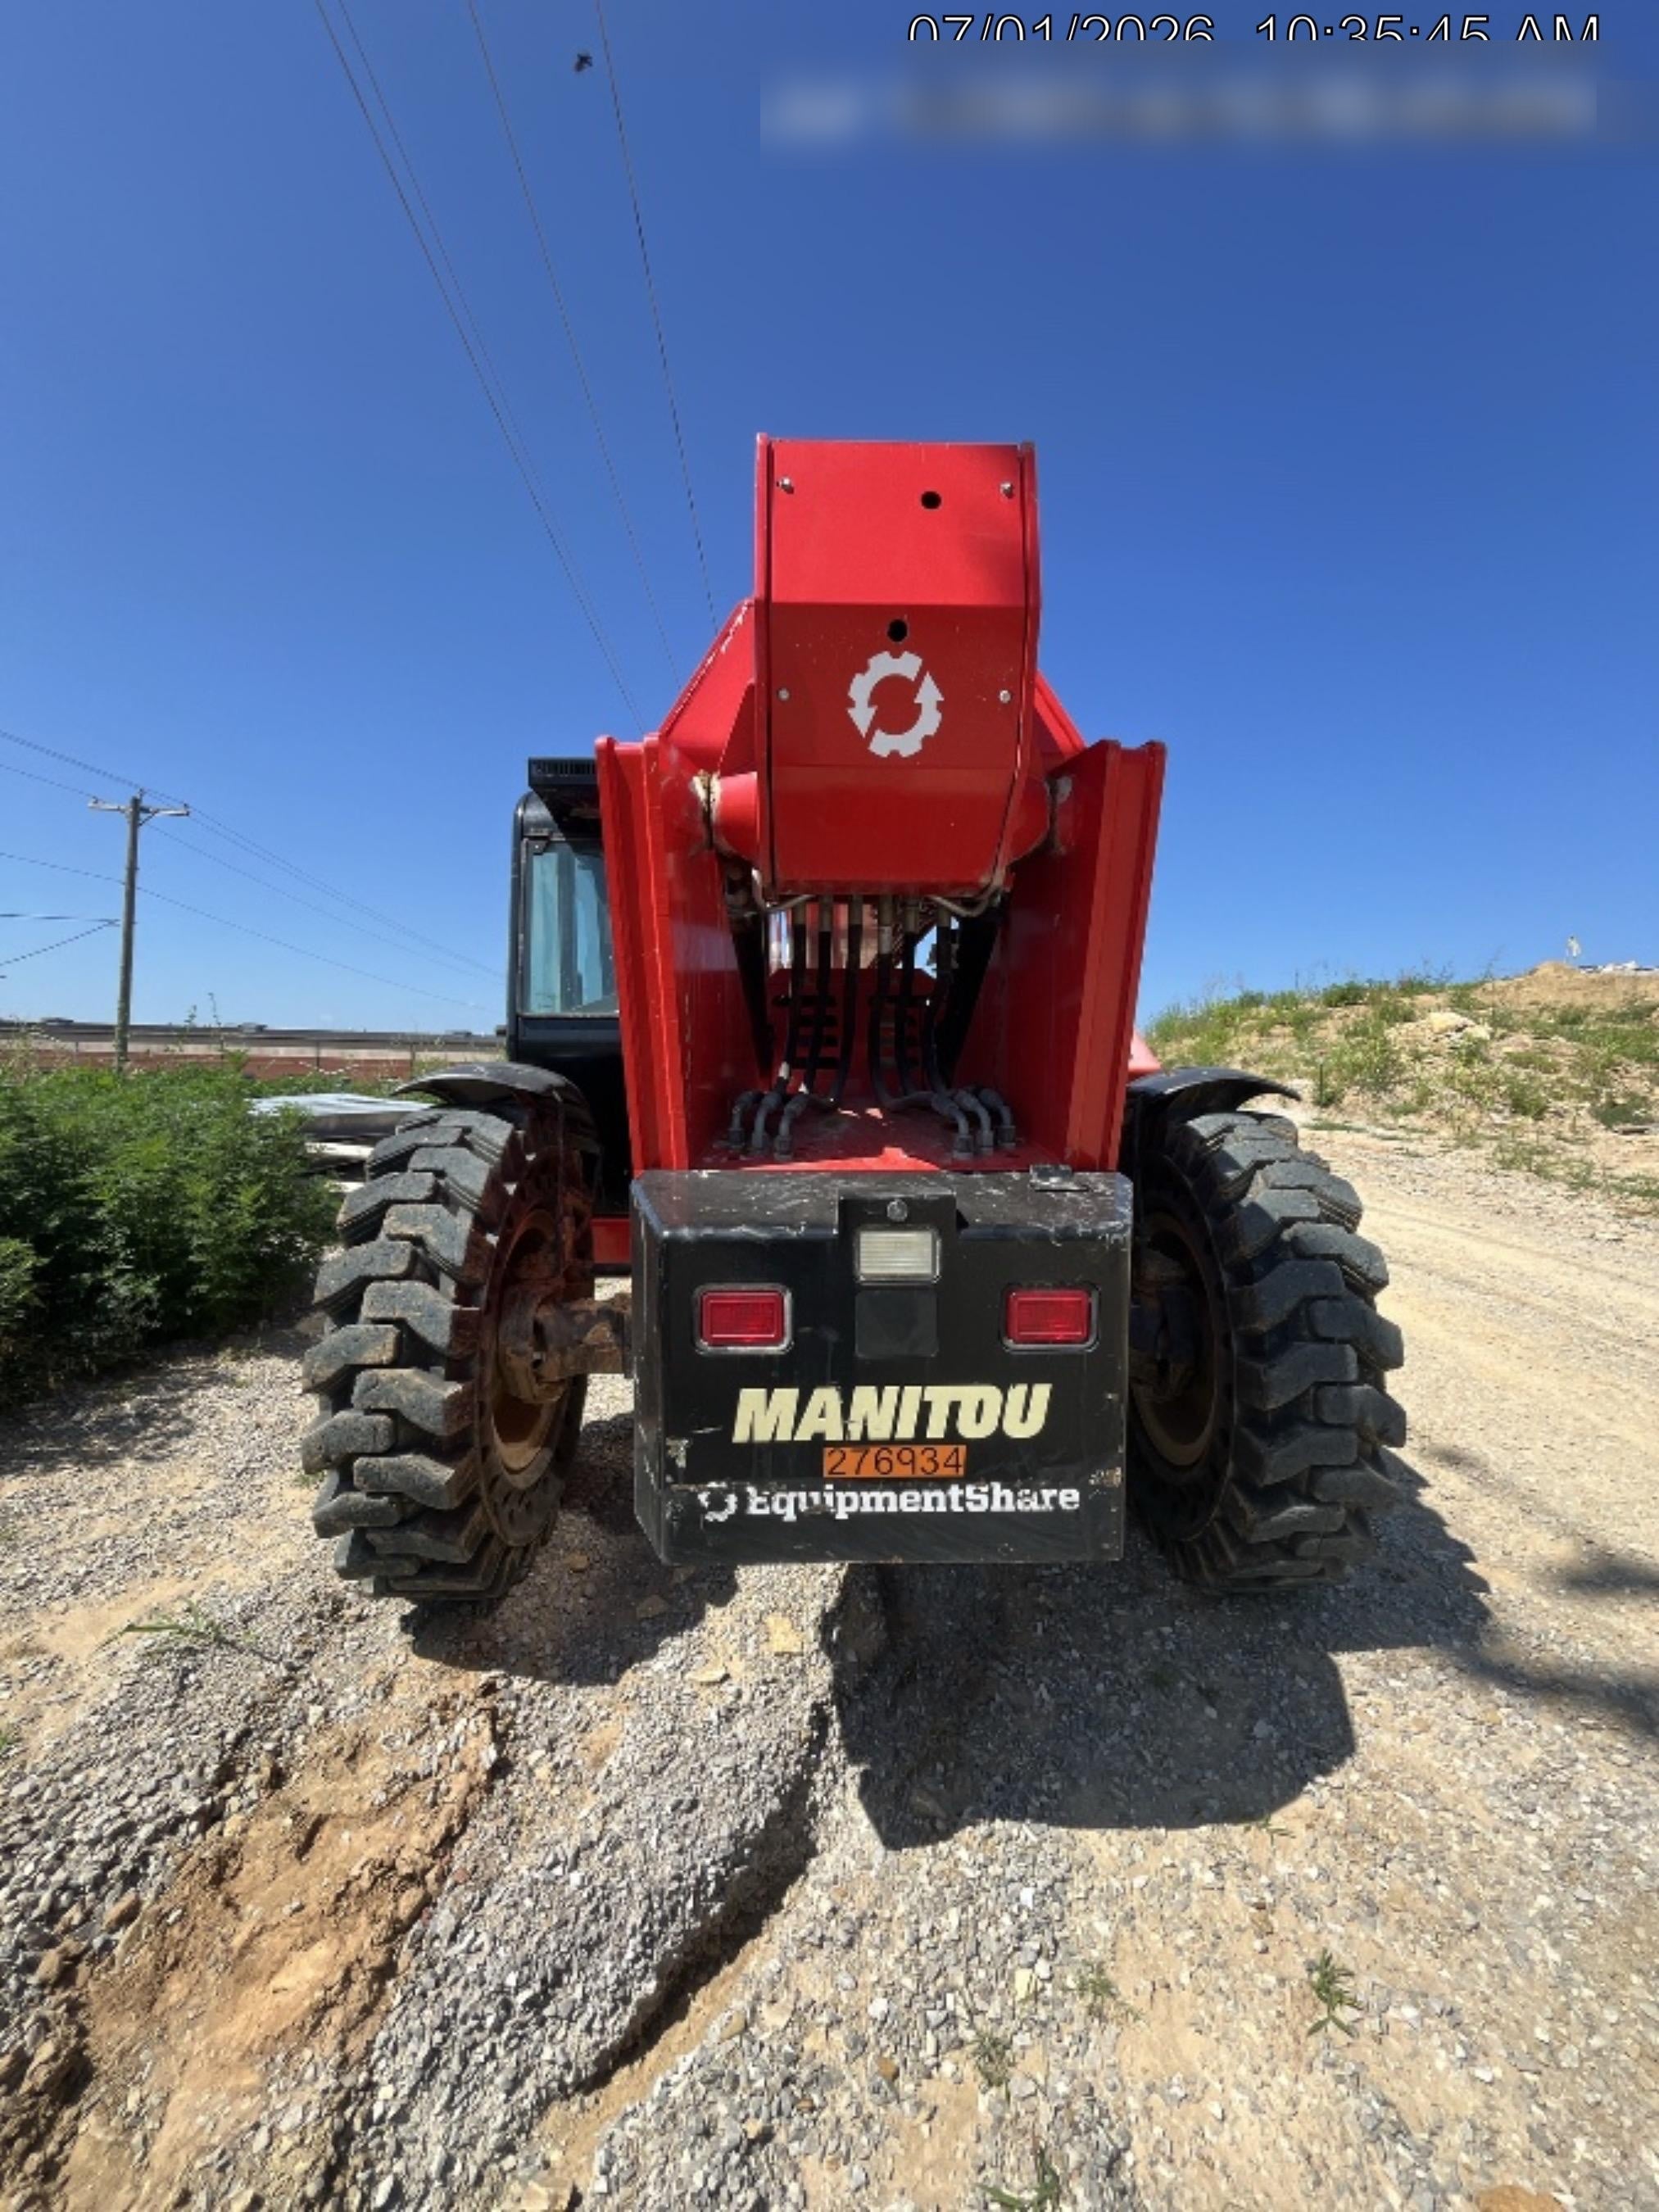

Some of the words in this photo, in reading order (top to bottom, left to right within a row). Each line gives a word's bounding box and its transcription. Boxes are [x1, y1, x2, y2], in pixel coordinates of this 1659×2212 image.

[732, 1383, 1052, 1443] MANITOU
[827, 1446, 964, 1475] 276934
[746, 1482, 1081, 1521] EquipmentShare
